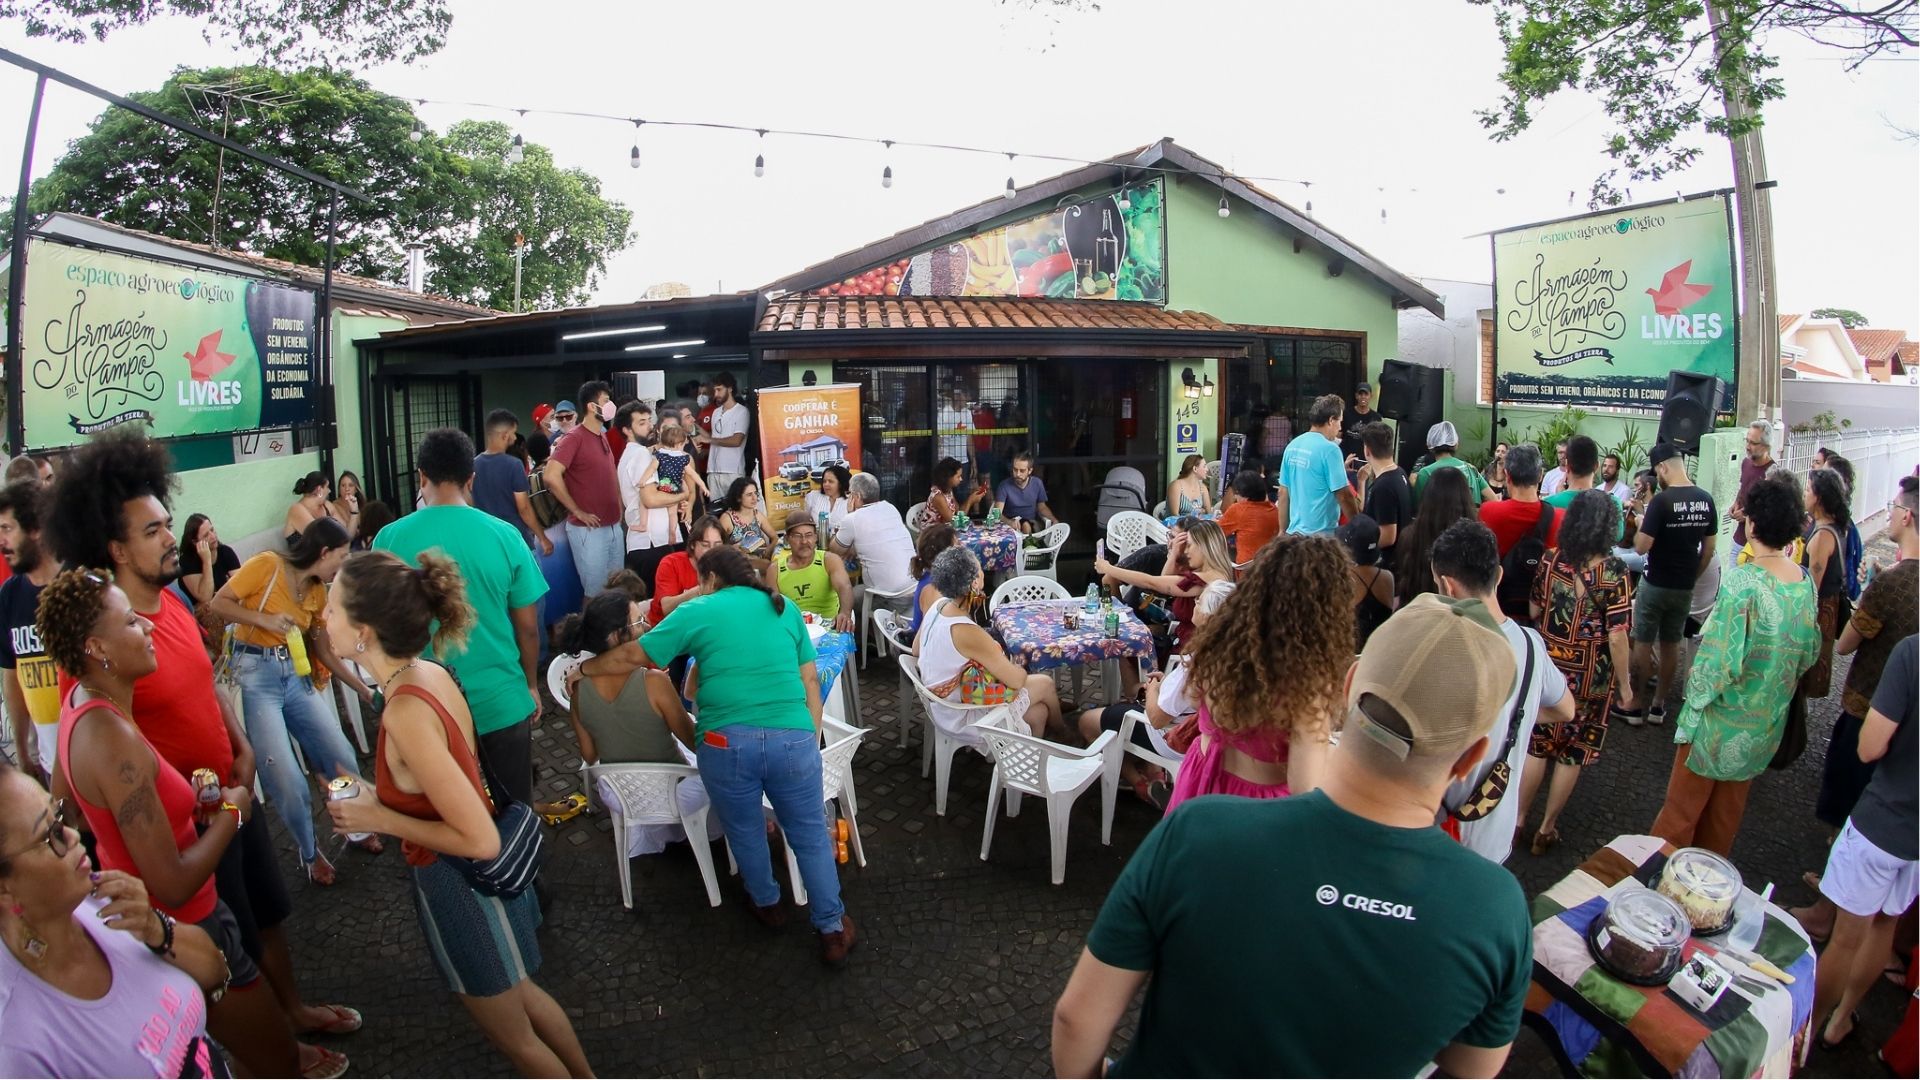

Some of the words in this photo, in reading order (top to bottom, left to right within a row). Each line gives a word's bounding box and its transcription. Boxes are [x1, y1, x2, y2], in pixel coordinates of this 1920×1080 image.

[272, 317, 305, 331] PRODUTOS
[1641, 313, 1722, 339] LIVRES
[267, 335, 281, 347] SEM
[267, 350, 302, 365] ORGÂNICOS
[304, 353, 308, 365] E
[266, 370, 276, 382] DA
[277, 370, 309, 382] ECONOMIA
[178, 381, 242, 406] LIVRES
[1509, 385, 1539, 395] PRODUTOS
[1541, 385, 1554, 395] SEM
[1555, 386, 1582, 397] VENENO,
[1583, 385, 1621, 398] ORGÂNICOS
[1622, 388, 1627, 398] E
[1629, 389, 1639, 399] DA
[783, 401, 829, 412] COOPERAR
[1176, 400, 1200, 421] 145
[784, 413, 839, 430] GANHAR
[1342, 893, 1417, 921] CRESOL
